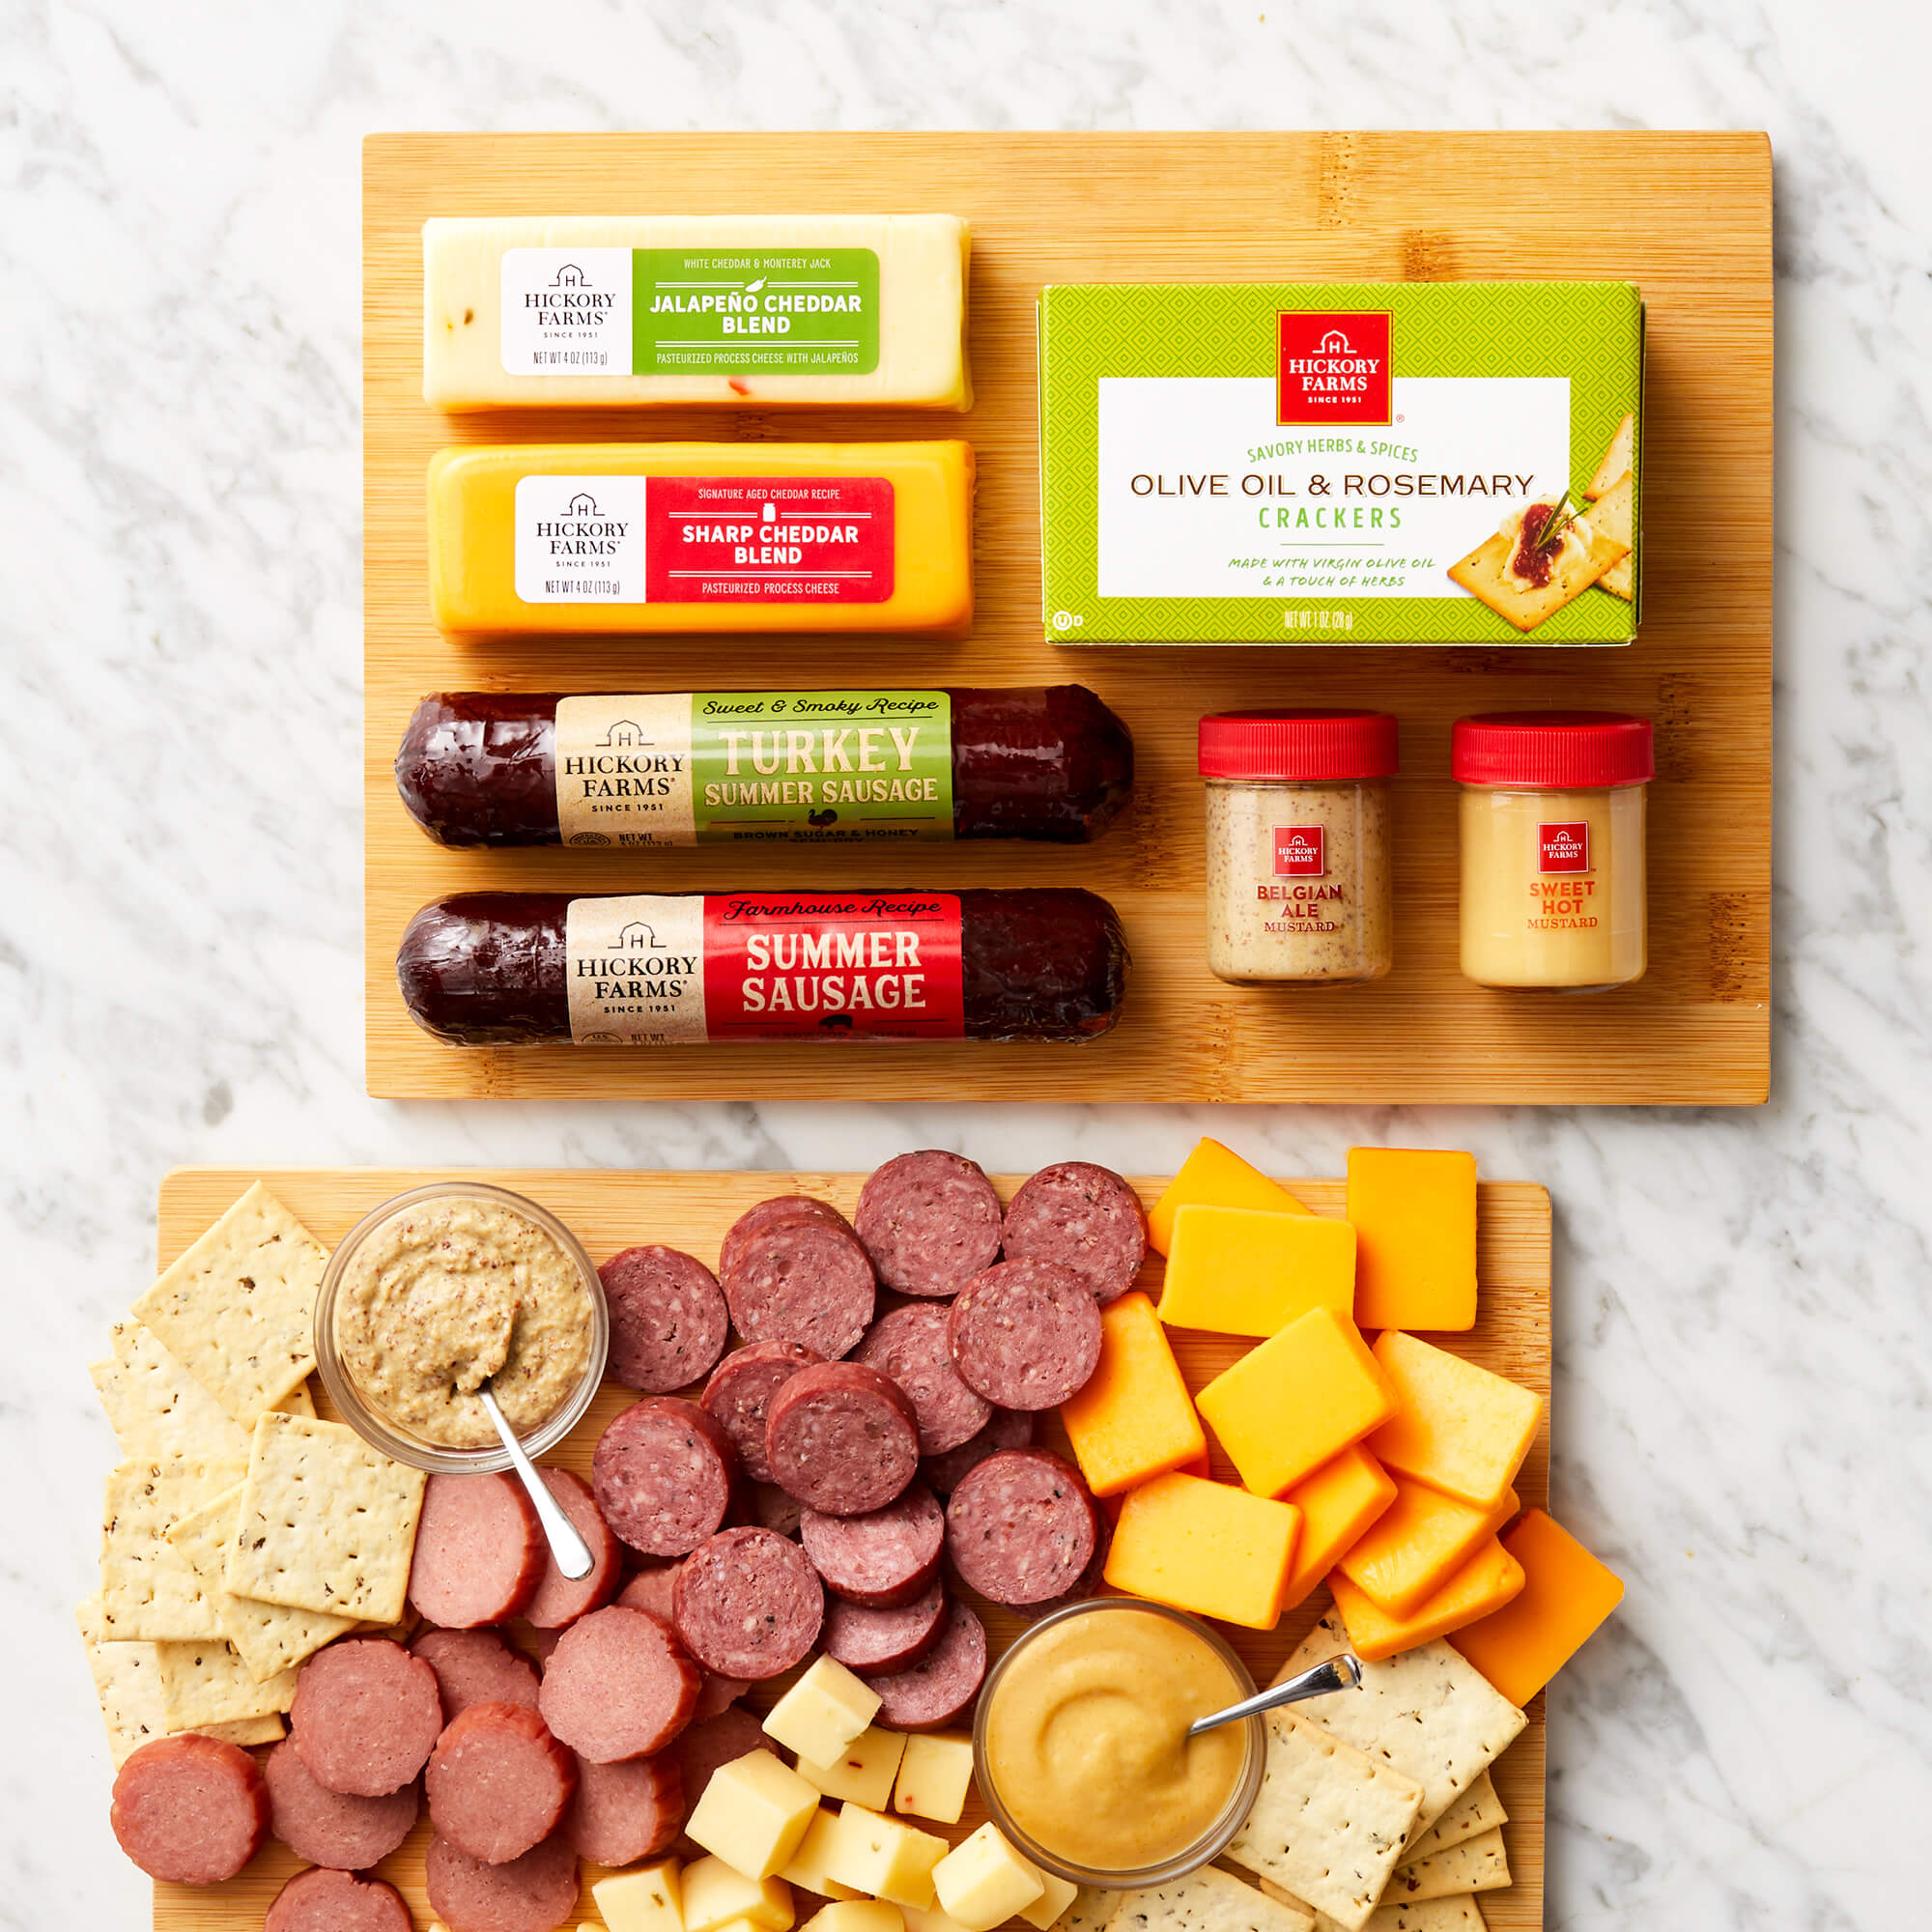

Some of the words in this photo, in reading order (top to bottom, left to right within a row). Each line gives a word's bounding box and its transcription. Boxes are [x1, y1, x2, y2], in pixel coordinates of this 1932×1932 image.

[684, 258, 709, 269] WHITE
[712, 258, 751, 269] CHEDDAR
[753, 258, 760, 269] &
[763, 258, 807, 269] MONTEREY
[810, 258, 831, 269] JACK
[565, 275, 576, 287] H
[525, 294, 616, 308] HICKORY
[649, 292, 756, 313] JALAPEÑO
[764, 295, 863, 313] CHEDDAR
[723, 316, 790, 334] BLEND
[1329, 341, 1340, 354] H
[533, 351, 547, 364] NET
[549, 351, 561, 364] WT
[563, 351, 568, 364] 4
[570, 351, 581, 364] OZ
[582, 351, 598, 365] (113
[657, 353, 712, 364] PASTEURIZED
[713, 353, 751, 364] PROCESS
[752, 353, 784, 364] CHEESE
[786, 353, 809, 364] WITH
[810, 351, 859, 364] JALAPEÑOS
[1289, 358, 1380, 374] HICKORY
[1301, 376, 1368, 391] FARMS
[1247, 440, 1303, 463] SAVORY
[1307, 439, 1352, 453] HERBS
[1356, 440, 1367, 453] &
[1370, 440, 1419, 463] SPICES
[1130, 474, 1230, 497] OLIVE
[1241, 474, 1297, 497] OIL
[1308, 474, 1332, 497] &
[1344, 474, 1536, 497] ROSEMARY
[698, 489, 744, 499] SIGNATURE
[746, 489, 768, 499] AGED
[770, 489, 809, 499] CHEDDAR
[810, 489, 840, 499] RECIPE
[578, 504, 588, 516] H
[1259, 507, 1402, 528] CRACKERS
[536, 523, 629, 537] HICKORY
[682, 525, 753, 543] SHARP
[759, 525, 859, 543] CHEDDAR
[734, 546, 803, 564] BLEND
[1228, 557, 1267, 568] MADE
[1272, 557, 1309, 568] WITH
[1313, 557, 1363, 570] VIRGIN
[1366, 557, 1406, 568] OLIVE
[1410, 557, 1437, 568] OIL
[546, 581, 560, 593] NET
[562, 581, 574, 593] WT
[576, 581, 581, 593] 4
[582, 581, 592, 593] OZ
[594, 581, 611, 595] (113
[702, 582, 760, 594] PASTEURIZED
[764, 582, 804, 594] PROCESS
[805, 582, 839, 594] CHEESE
[1263, 576, 1272, 586] &
[1276, 577, 1285, 586] A
[1290, 576, 1335, 586] TOUCH
[1340, 576, 1358, 587] OF
[1361, 576, 1406, 587] HERBS
[1285, 611, 1297, 628] NET
[702, 699, 763, 716] Sweet
[771, 699, 786, 714] &
[792, 698, 862, 716] Smoky
[866, 697, 939, 715] Recipe
[618, 732, 632, 746] H
[718, 726, 921, 777] TURKEY
[565, 753, 686, 776] HICKORY
[704, 781, 816, 807] SUMMER
[821, 777, 938, 805] SAUSAGE
[733, 831, 788, 839] BROWN
[793, 829, 846, 838] SUGAR
[866, 828, 919, 838] HONEY
[1543, 842, 1583, 851] HICKORY
[1257, 884, 1343, 901] BELGIAN
[1529, 880, 1595, 897] SWEET
[724, 899, 857, 921] Farmhouse
[860, 898, 942, 916] Recipe
[1281, 903, 1319, 919] ALE
[1542, 899, 1583, 916] HOT
[1264, 921, 1335, 932] MUSTARD
[1526, 917, 1599, 929] MUSTARD
[631, 935, 642, 948] H
[747, 931, 922, 971] SUMMER
[577, 956, 697, 978] HICKORY
[742, 974, 926, 1012] SAUSAGE
